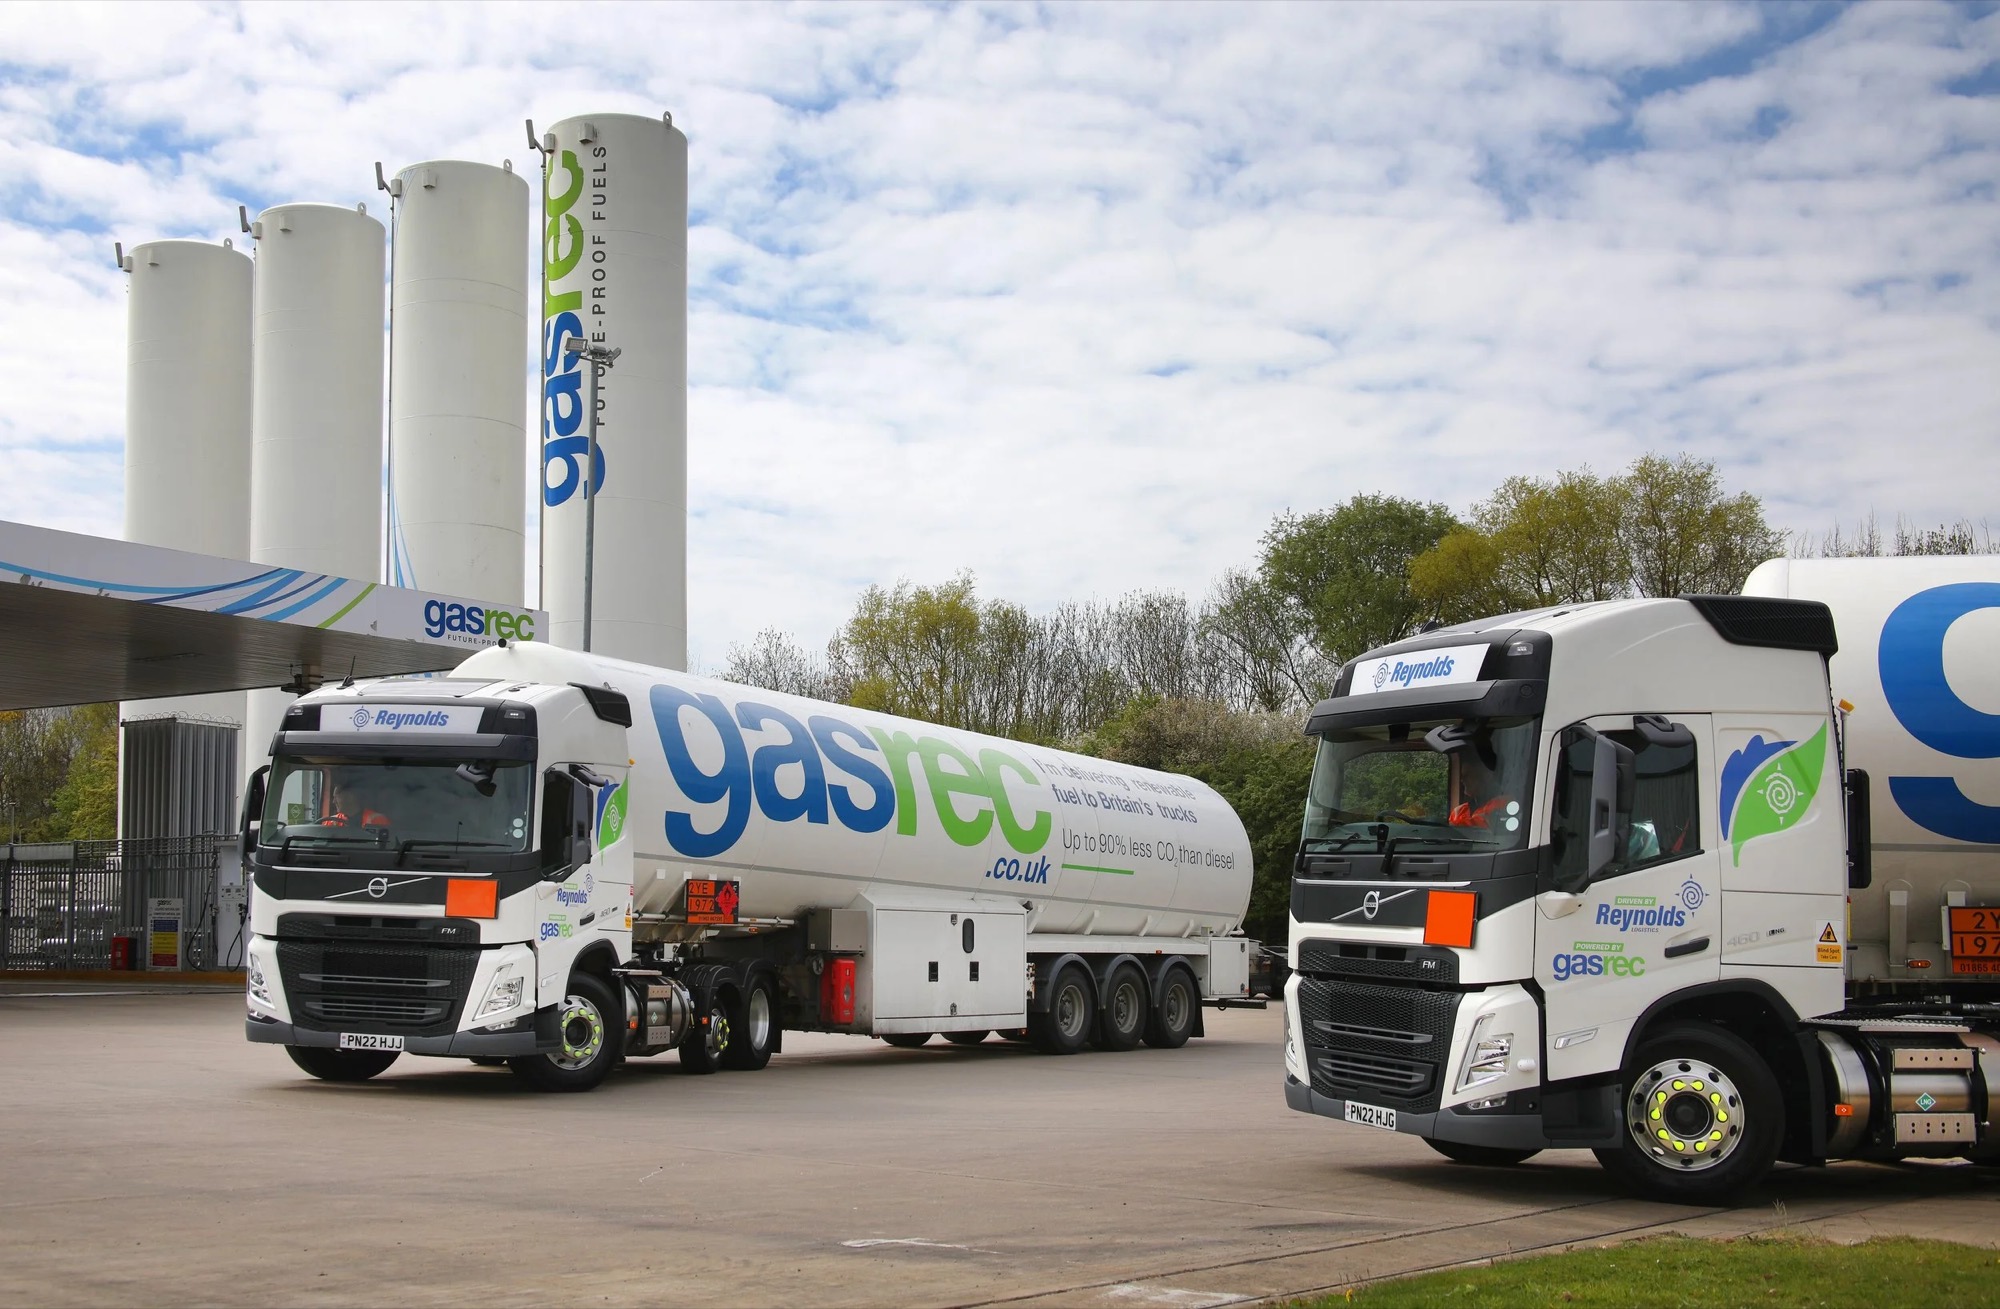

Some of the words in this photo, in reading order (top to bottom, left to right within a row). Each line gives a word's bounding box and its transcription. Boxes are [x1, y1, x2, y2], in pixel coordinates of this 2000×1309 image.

[592, 146, 607, 221] FUELS
[545, 149, 605, 507] gasrec
[424, 600, 535, 641] gasrec
[1390, 656, 1455, 687] Reynolds
[374, 710, 449, 729] Reynolds
[650, 684, 1052, 858] gasrec
[1032, 758, 1063, 777] I'm
[1061, 762, 1131, 792] delivering
[1130, 777, 1196, 801] renewable
[1051, 783, 1082, 805] fuel
[1081, 788, 1098, 809] to
[1096, 790, 1154, 817] Britain's
[1156, 801, 1198, 824] trucks
[1062, 828, 1081, 855] Up
[1084, 831, 1097, 852] to
[1099, 833, 1127, 856] 90%
[1129, 837, 1152, 859] less
[1179, 845, 1203, 866] than
[1205, 849, 1235, 871] diesel
[985, 855, 1052, 884] .co.uk
[557, 887, 588, 907] Reynolds
[689, 882, 708, 895] 2YE
[1617, 897, 1643, 905] DRIVEN
[689, 898, 715, 912] 1972
[1595, 903, 1686, 932] Reynolds
[540, 922, 573, 941] gasrec
[1575, 943, 1610, 951] POWERED
[1422, 960, 1436, 969] FM
[1552, 953, 1646, 981] gasrec
[347, 1034, 377, 1048] PN22
[379, 1036, 403, 1049] HJJ
[1350, 1104, 1374, 1123] PN22
[1376, 1109, 1395, 1128] HJG
